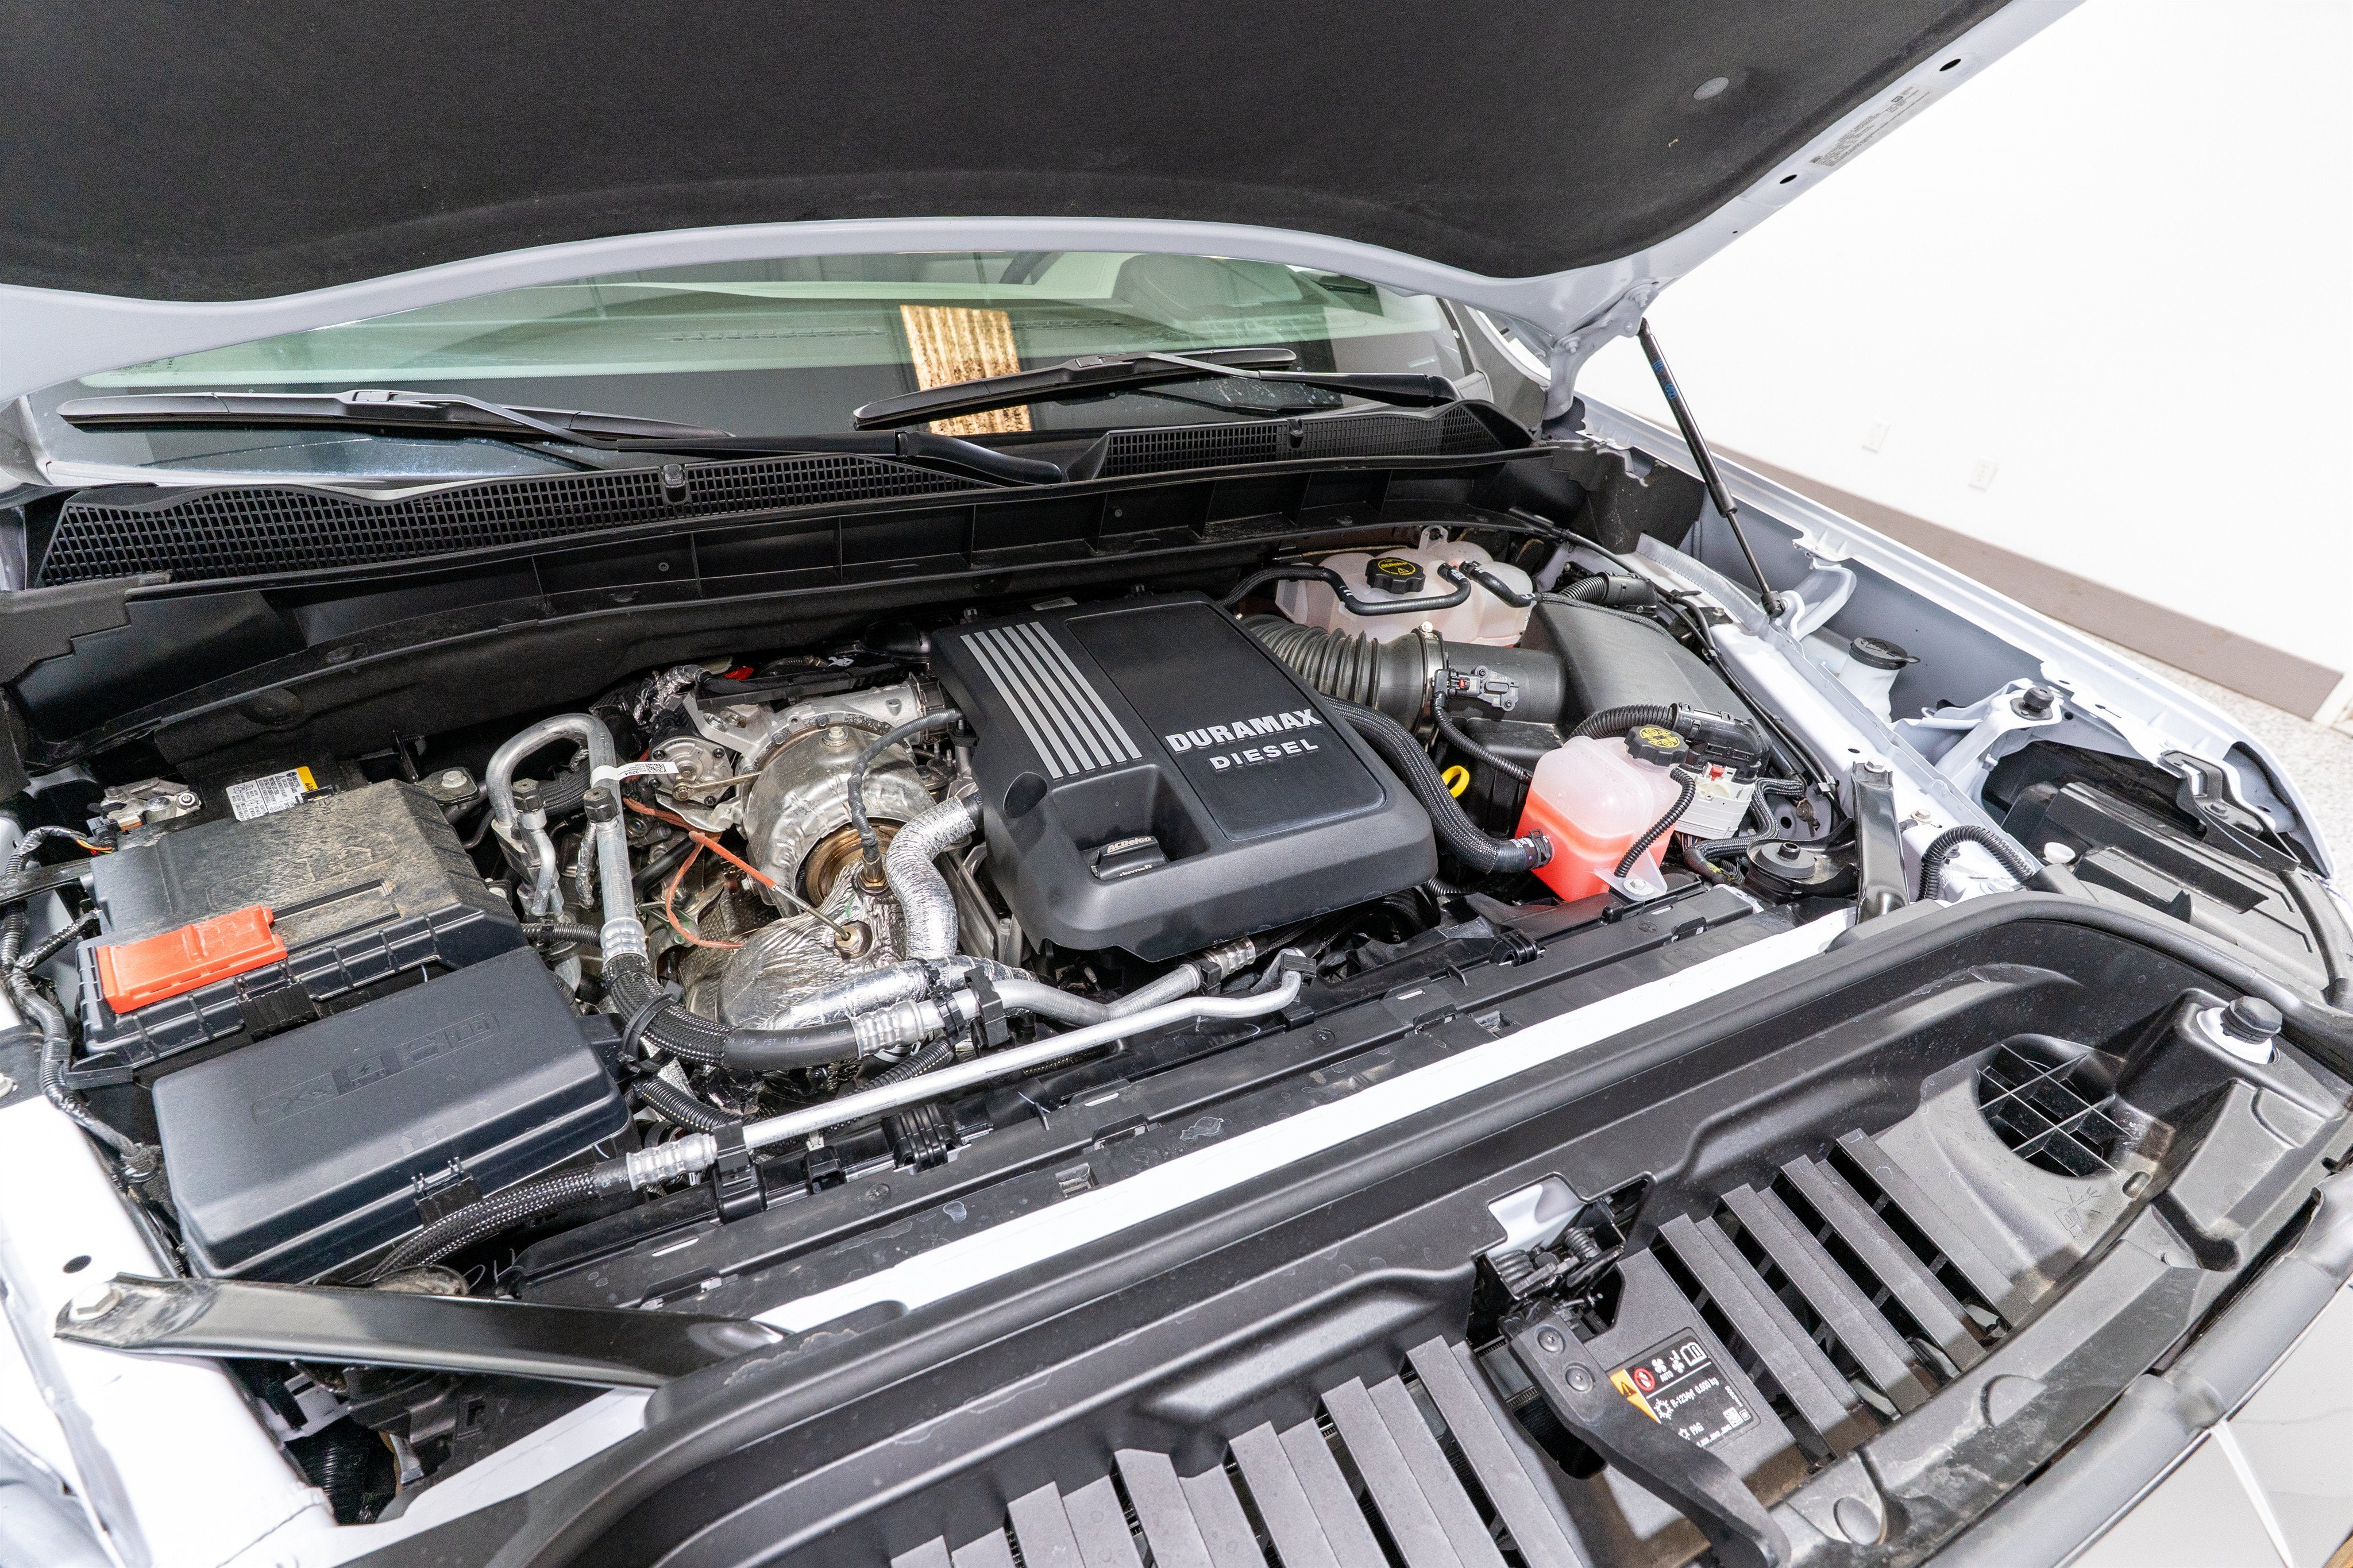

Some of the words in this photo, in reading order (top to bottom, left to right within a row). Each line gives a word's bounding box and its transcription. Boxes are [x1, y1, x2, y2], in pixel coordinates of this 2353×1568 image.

[1165, 709, 1322, 752] DURAMAX
[1209, 739, 1319, 771] DIESEL
[1106, 837, 1152, 853] ACDelco
[1660, 1370, 1674, 1382] AUTO
[1708, 1377, 1719, 1387] kg
[1689, 1422, 1704, 1436] PAG
